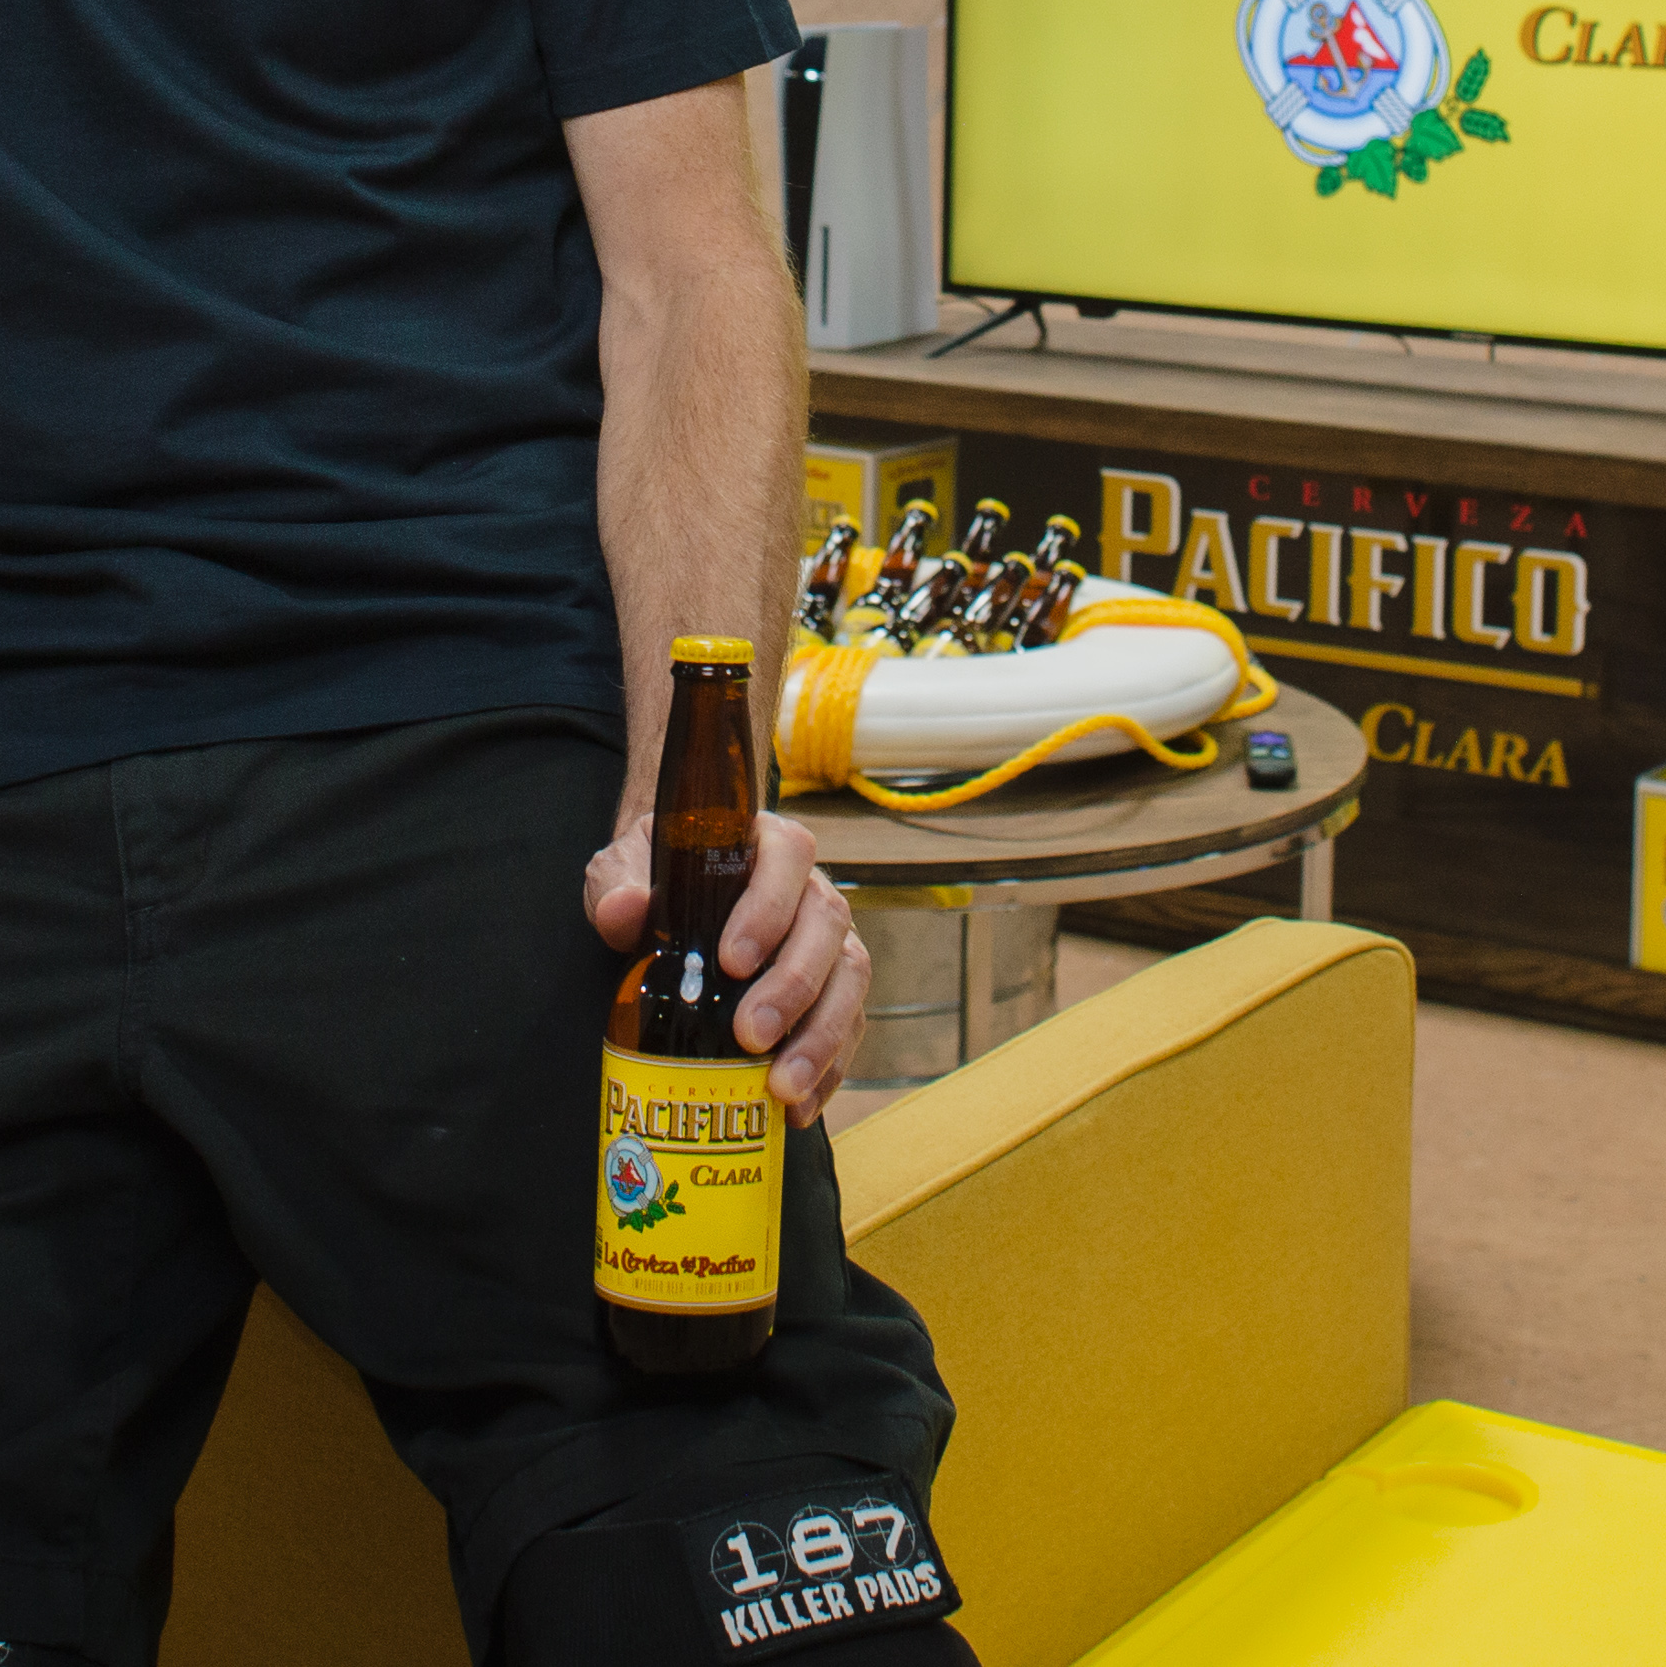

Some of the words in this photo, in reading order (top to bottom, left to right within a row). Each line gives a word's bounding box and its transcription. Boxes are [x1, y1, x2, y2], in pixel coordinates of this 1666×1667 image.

[1248, 475, 1588, 539] CERVEZA
[1099, 468, 1591, 657] PACIFICO
[1360, 703, 1571, 788] CLARA
[605, 1076, 769, 1142] PACIFICO
[690, 1165, 763, 1186] CLARA
[604, 1241, 619, 1270] La
[726, 1504, 906, 1595] 187
[720, 1580, 855, 1648] KILLER
[854, 1559, 942, 1614] PADS
